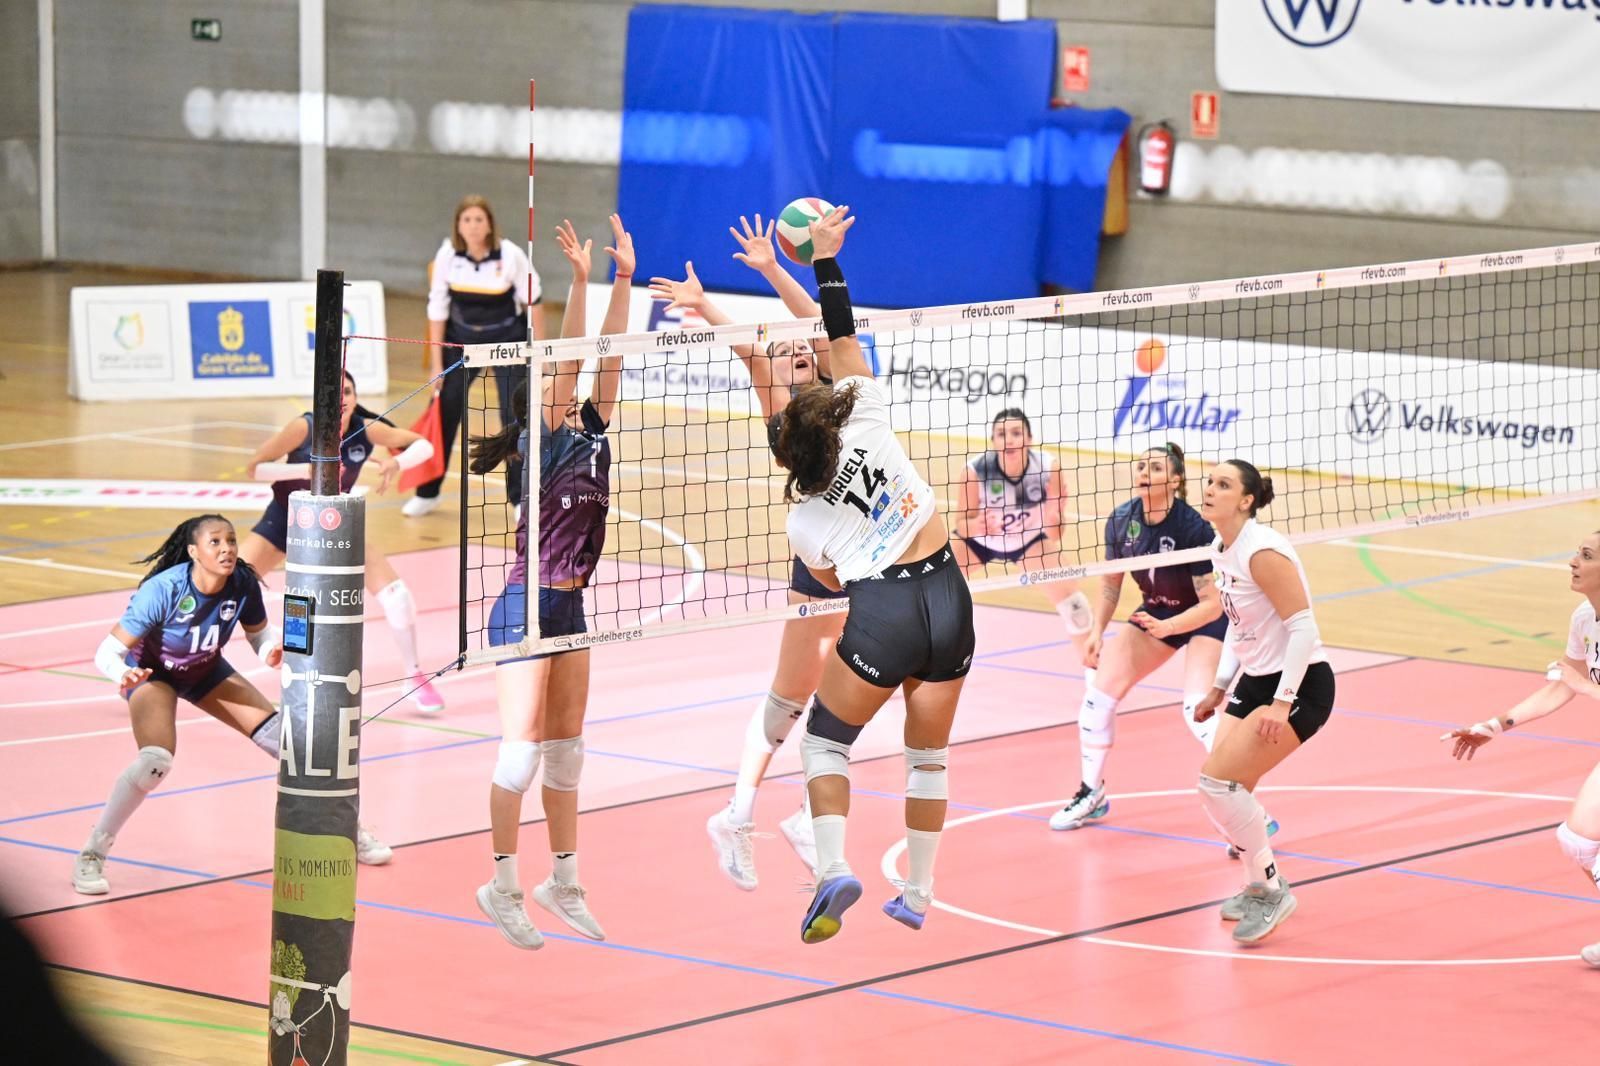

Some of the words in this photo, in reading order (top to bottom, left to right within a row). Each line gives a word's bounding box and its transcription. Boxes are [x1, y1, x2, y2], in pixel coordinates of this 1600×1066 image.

[1480, 254, 1523, 268] rfevb.com
[1361, 266, 1406, 280] rfevb.com
[1235, 279, 1283, 293] rfevb.com
[1102, 292, 1153, 306] rfevb.com
[962, 304, 1015, 319] rfevb.com
[656, 330, 715, 346] rfevb.com
[886, 354, 1028, 403] Hexagon
[1112, 375, 1240, 439] Insular
[1402, 403, 1575, 449] Volkswagen
[823, 448, 868, 506] HIRUELA
[842, 464, 888, 519] 14
[189, 624, 220, 654] 14
[575, 630, 643, 646] cdheidelberg.es
[853, 653, 880, 678] fix&fit
[299, 858, 352, 878] MOMENTOS
